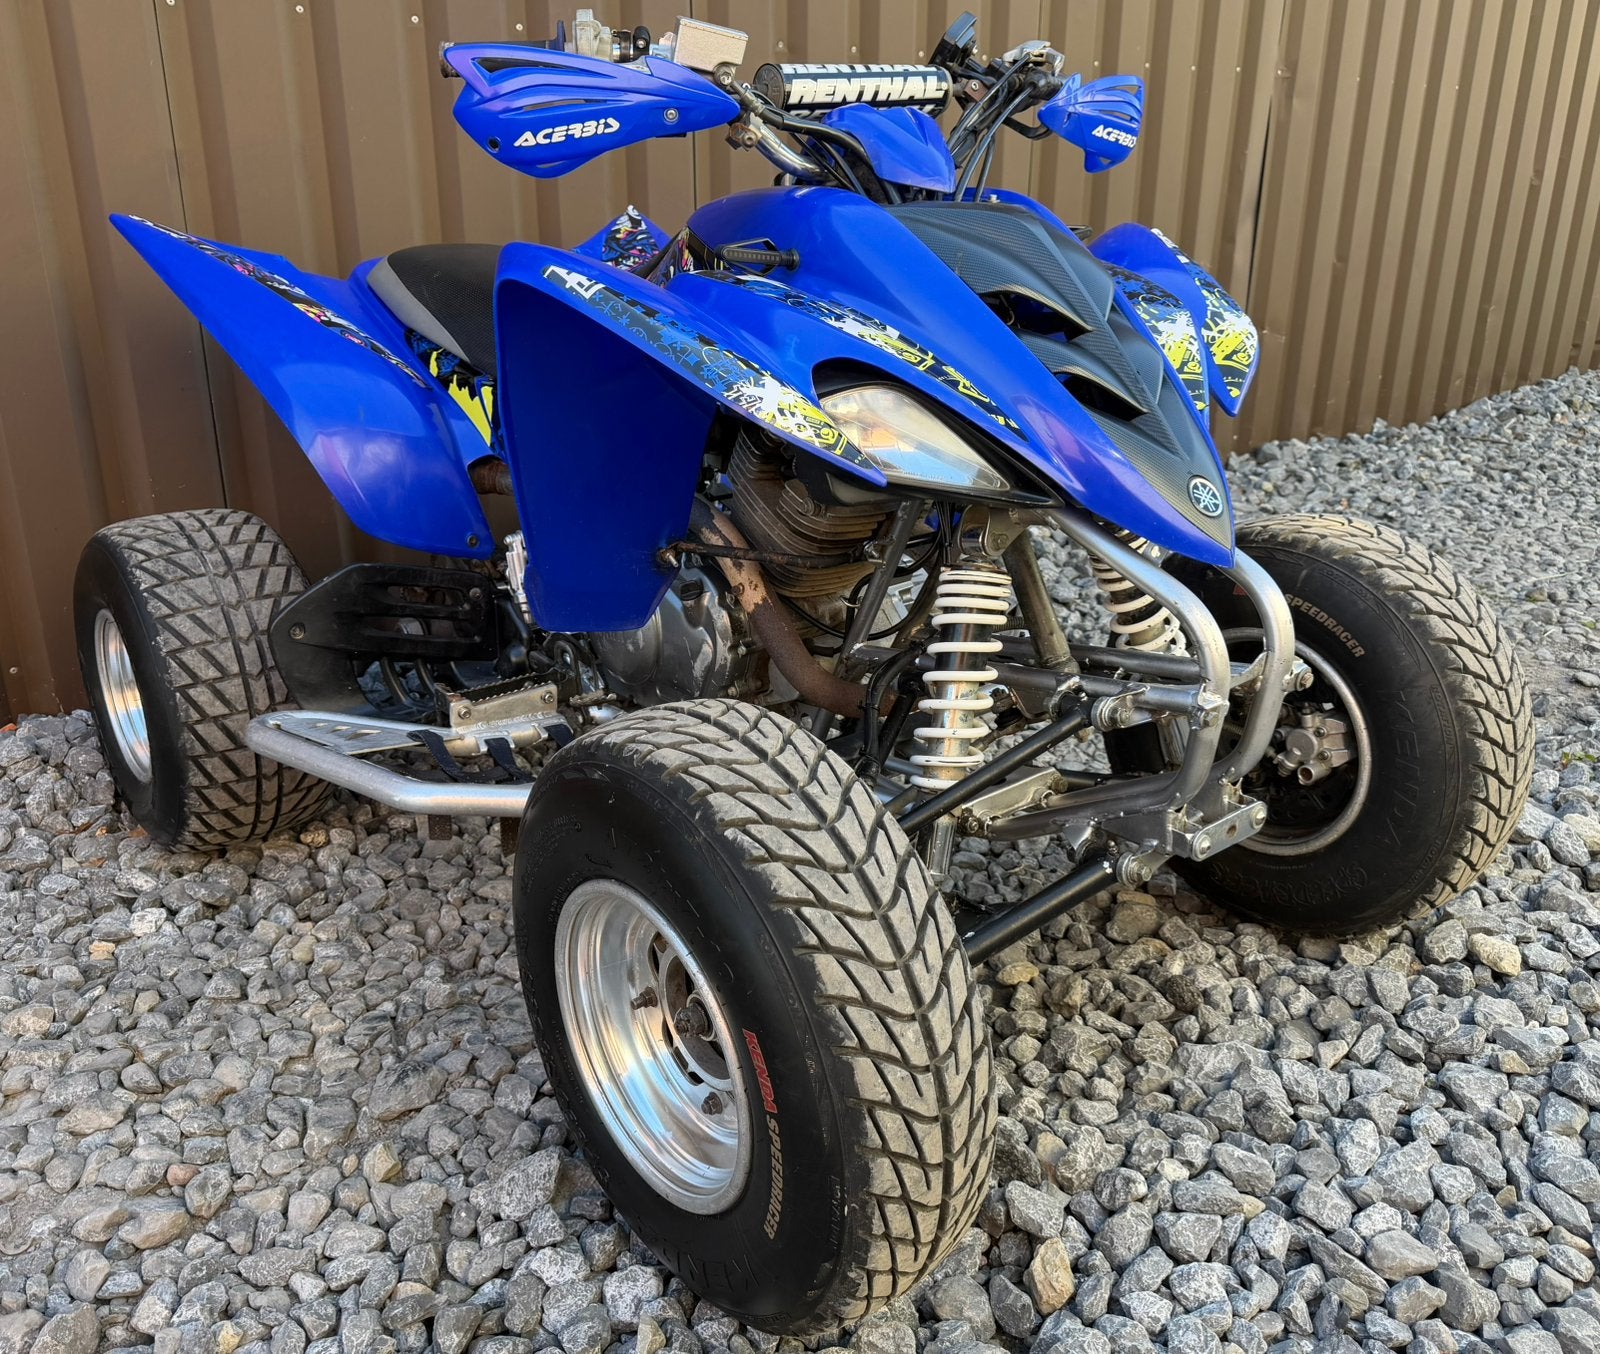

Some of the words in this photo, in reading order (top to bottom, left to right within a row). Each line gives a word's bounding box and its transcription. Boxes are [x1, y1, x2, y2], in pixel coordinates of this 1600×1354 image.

[787, 76, 945, 105] RENTHAL
[1284, 593, 1366, 658] SPEEDRACER
[742, 1028, 778, 1114] KENDA
[763, 1114, 784, 1240] SPEEDRACER
